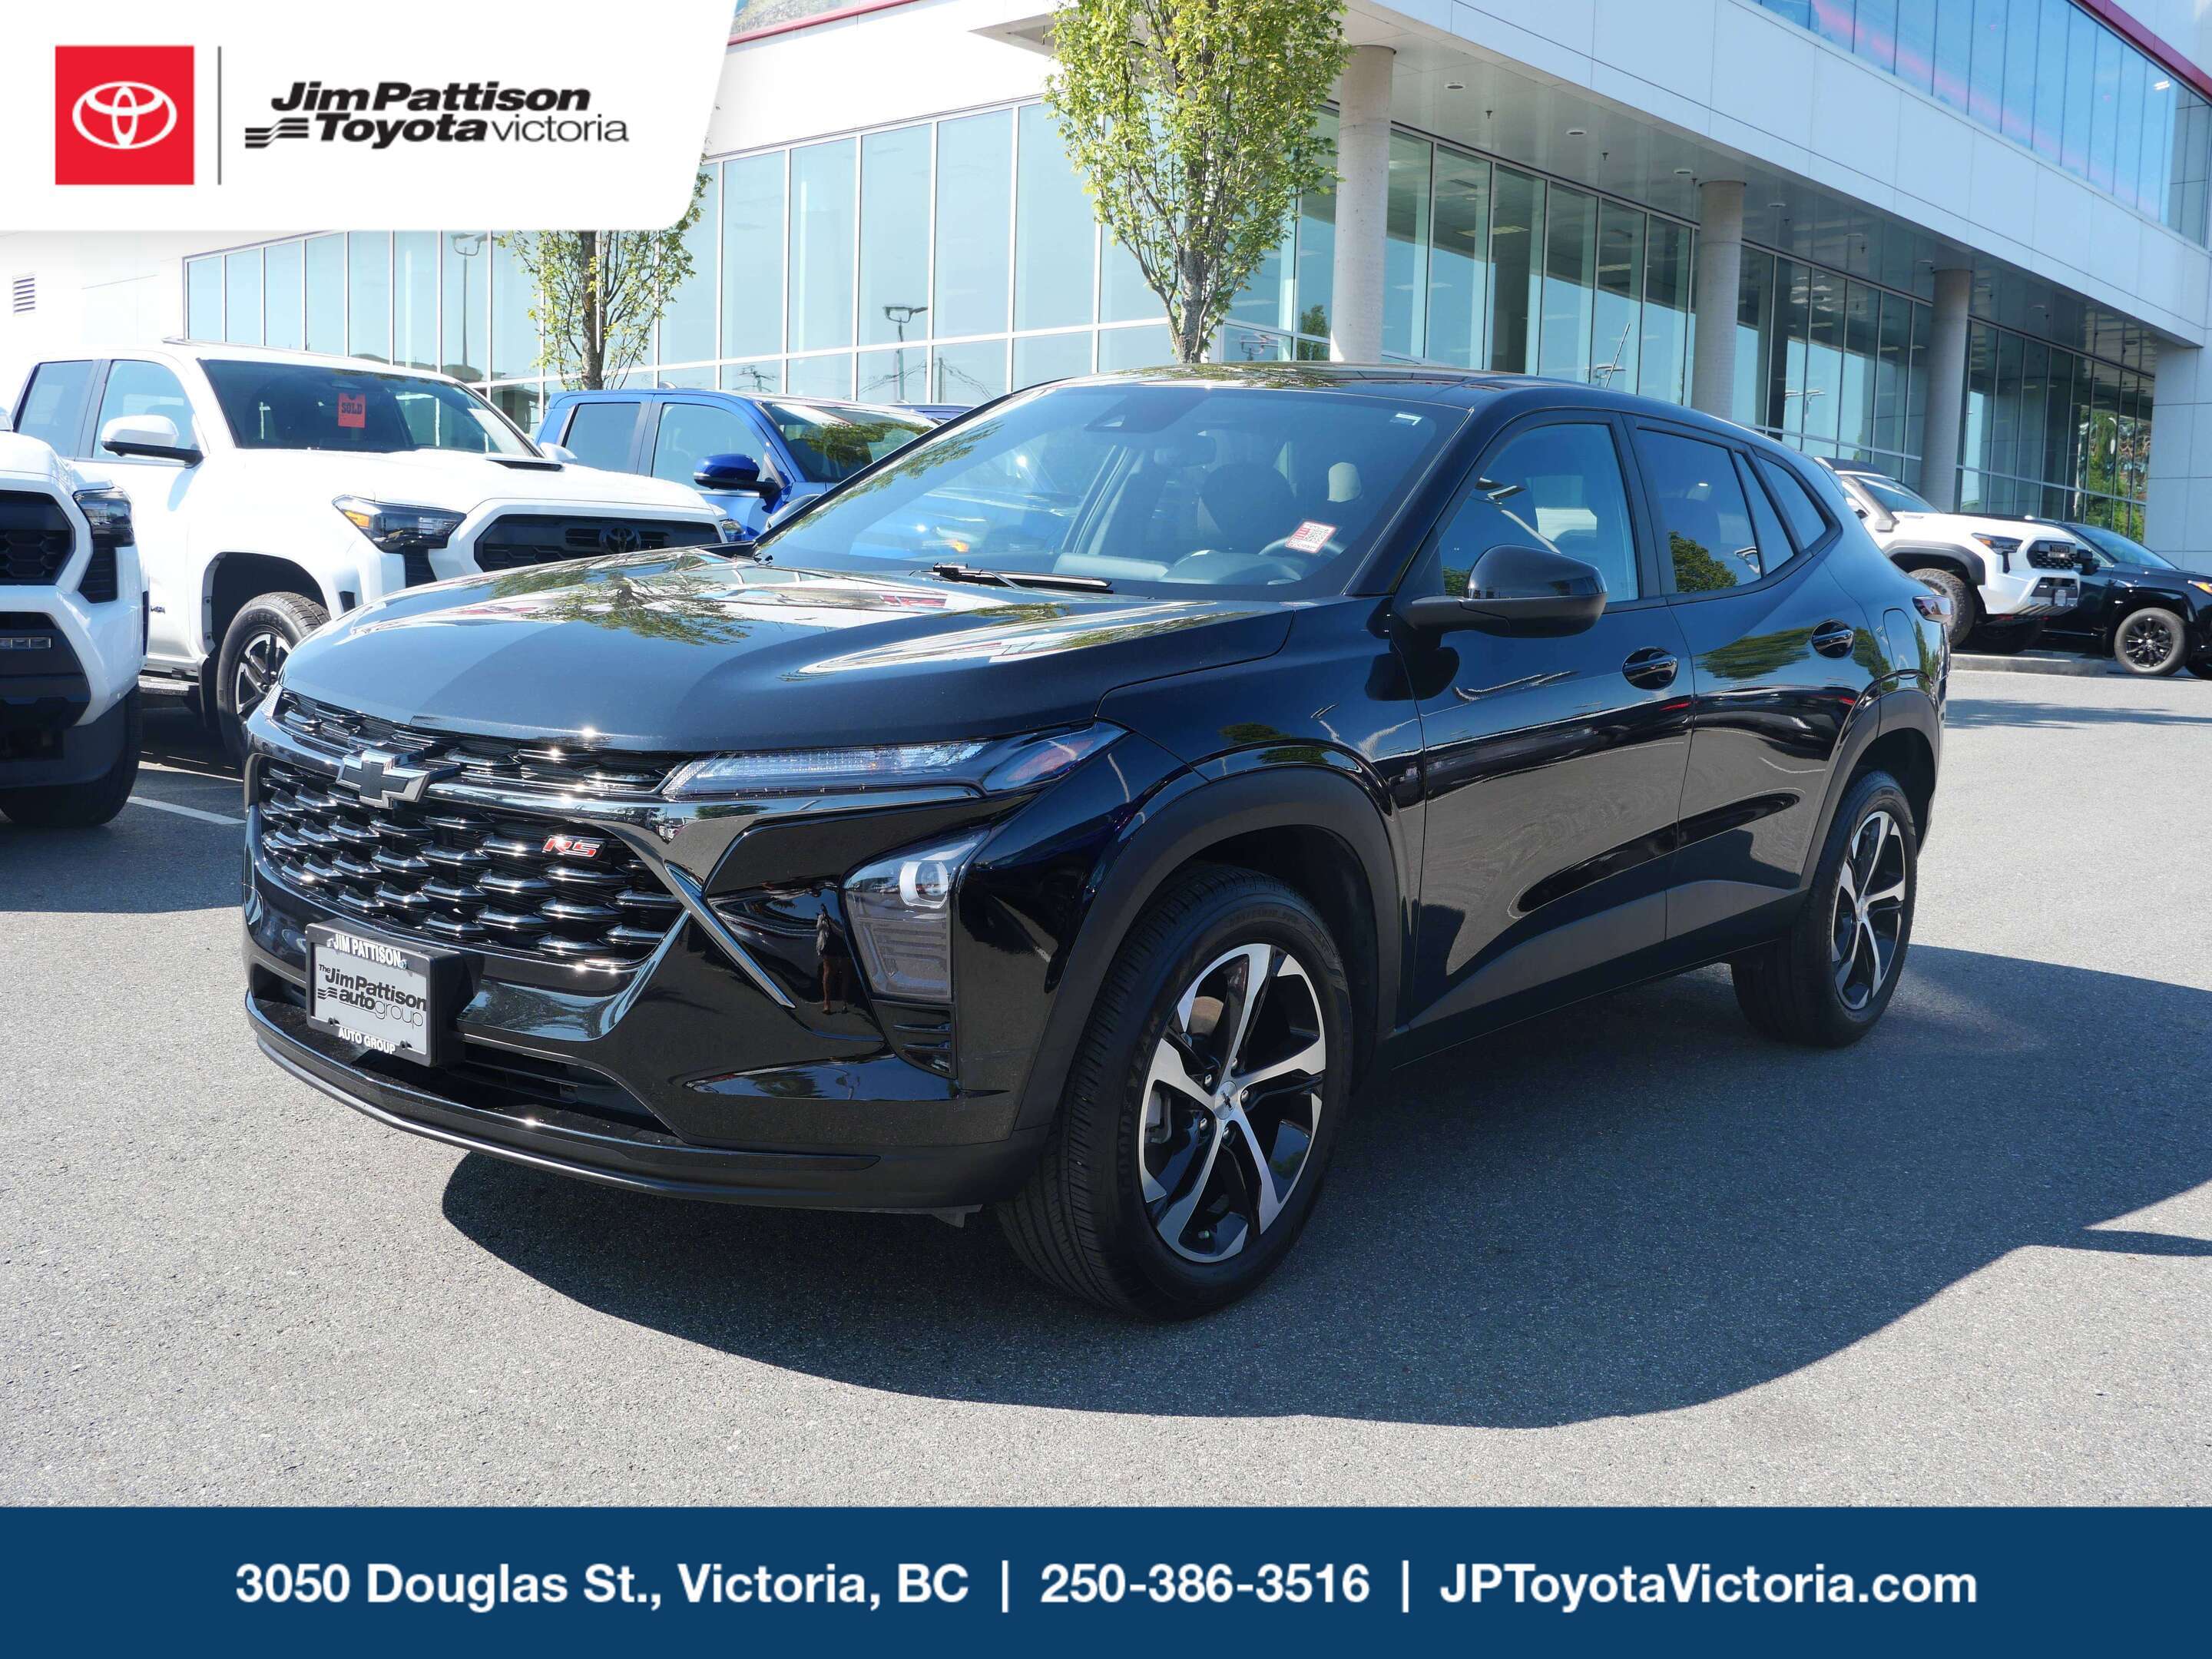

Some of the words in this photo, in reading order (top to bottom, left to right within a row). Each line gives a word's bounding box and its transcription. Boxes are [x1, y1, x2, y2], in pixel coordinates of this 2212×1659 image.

[342, 402, 363, 415] SOLD
[542, 836, 600, 858] RS
[333, 933, 350, 954] JIM
[352, 939, 401, 967] PATTISON
[319, 964, 331, 974] The
[338, 1027, 363, 1045] AUTO
[363, 1035, 396, 1055] GROUP
